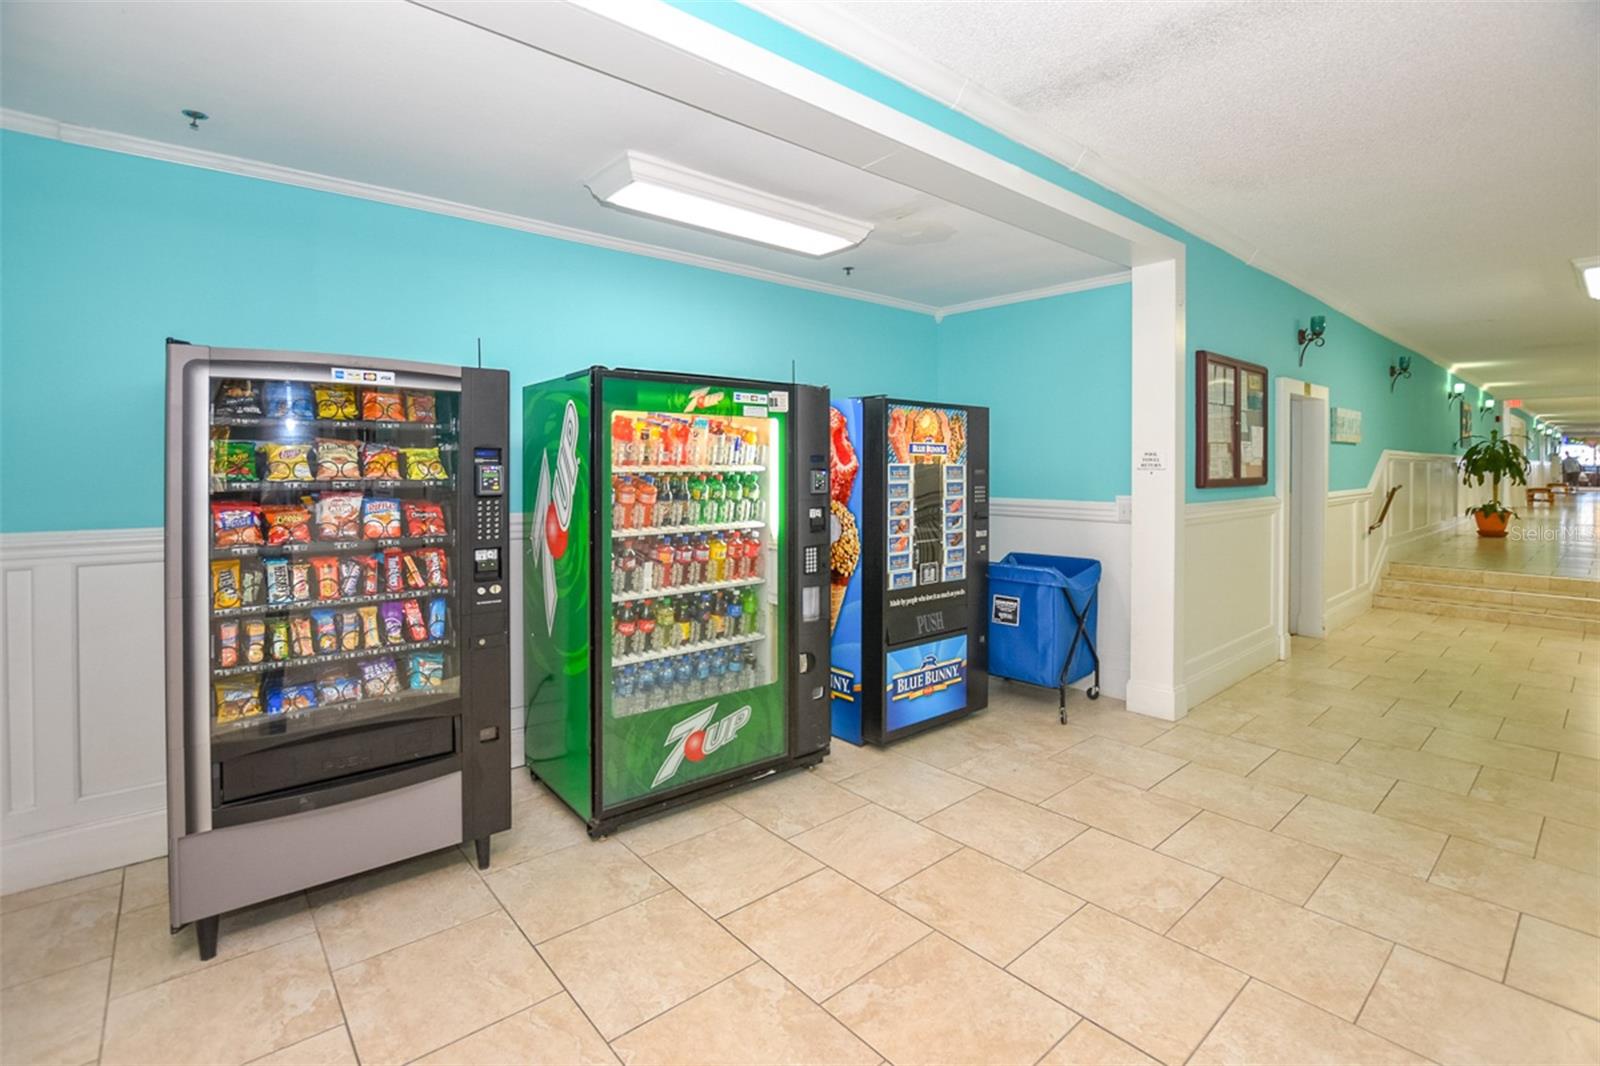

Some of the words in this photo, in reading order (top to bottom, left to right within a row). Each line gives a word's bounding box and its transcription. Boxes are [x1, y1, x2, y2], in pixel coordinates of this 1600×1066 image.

[916, 611, 945, 634] PUSH
[896, 673, 924, 693] BLUE
[924, 664, 960, 686] BUNNY
[650, 702, 752, 789] 7UP
